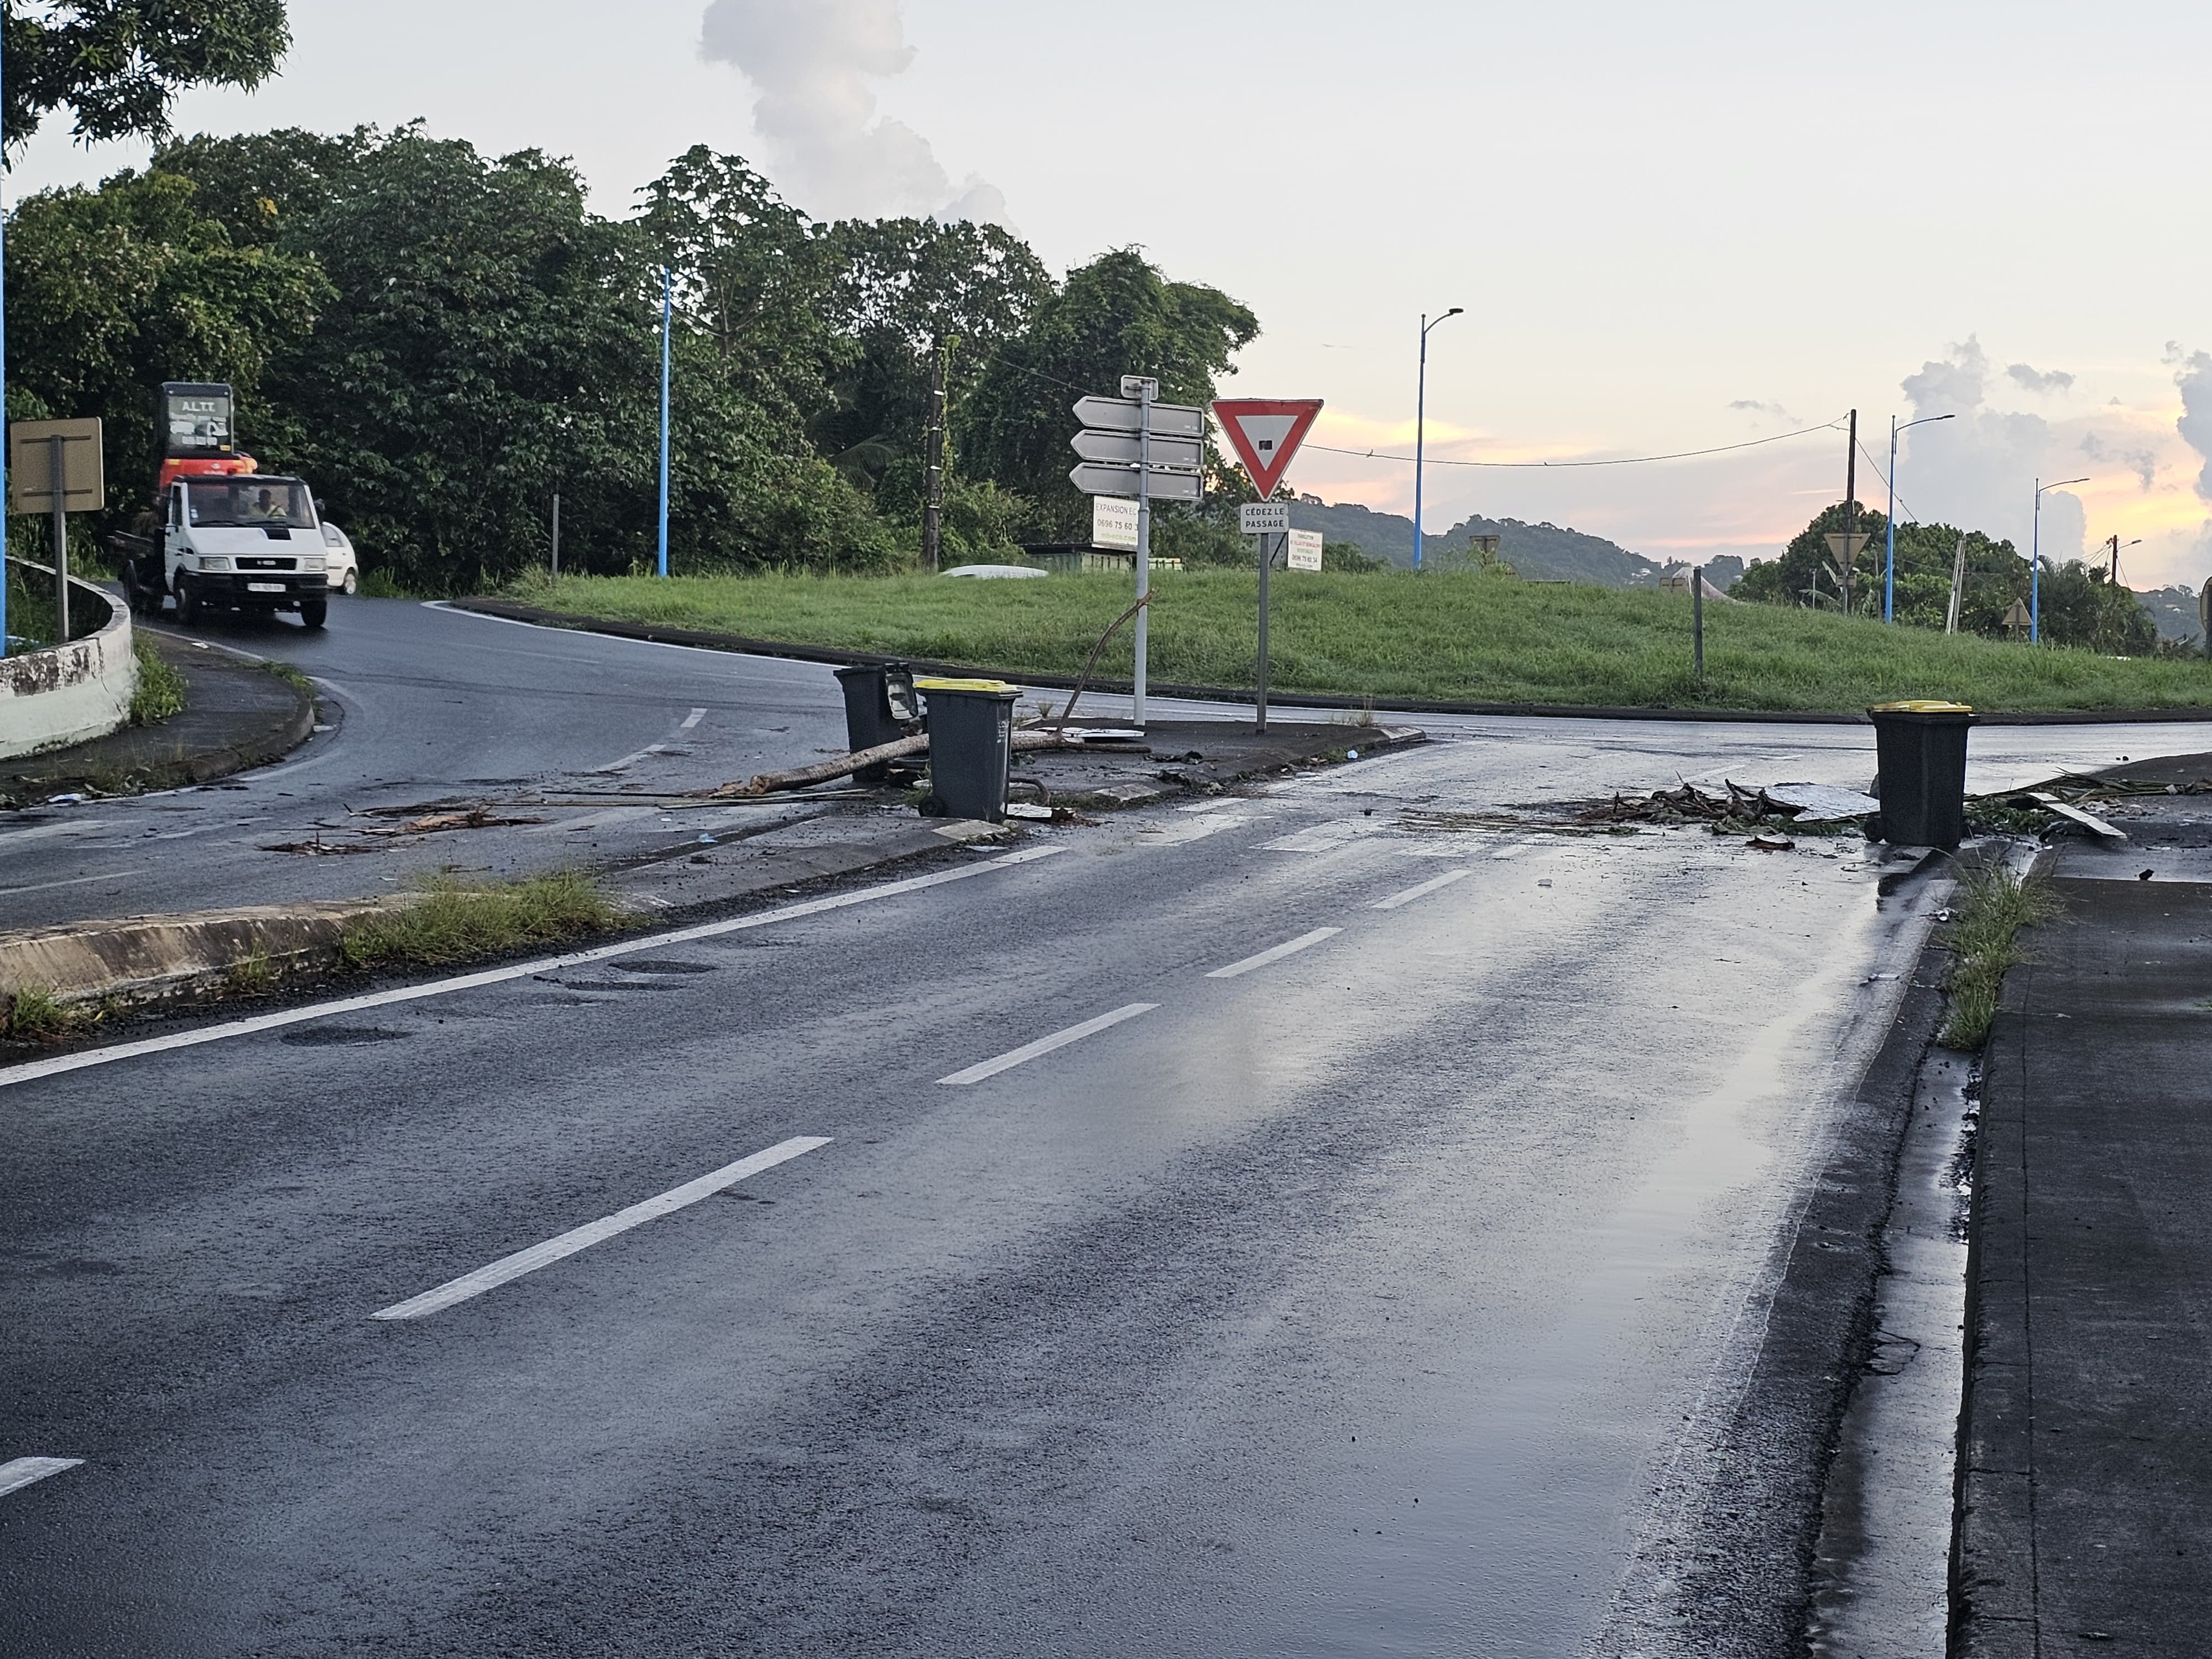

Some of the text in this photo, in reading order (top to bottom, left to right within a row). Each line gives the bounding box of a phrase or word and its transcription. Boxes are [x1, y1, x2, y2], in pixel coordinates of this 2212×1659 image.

[1096, 503, 1137, 515] EXPANSION EC
[1245, 507, 1272, 516] CÉDEZ
[1097, 519, 1113, 528] 0696
[1114, 521, 1123, 529] 75
[1245, 520, 1284, 528] PASSAGE
